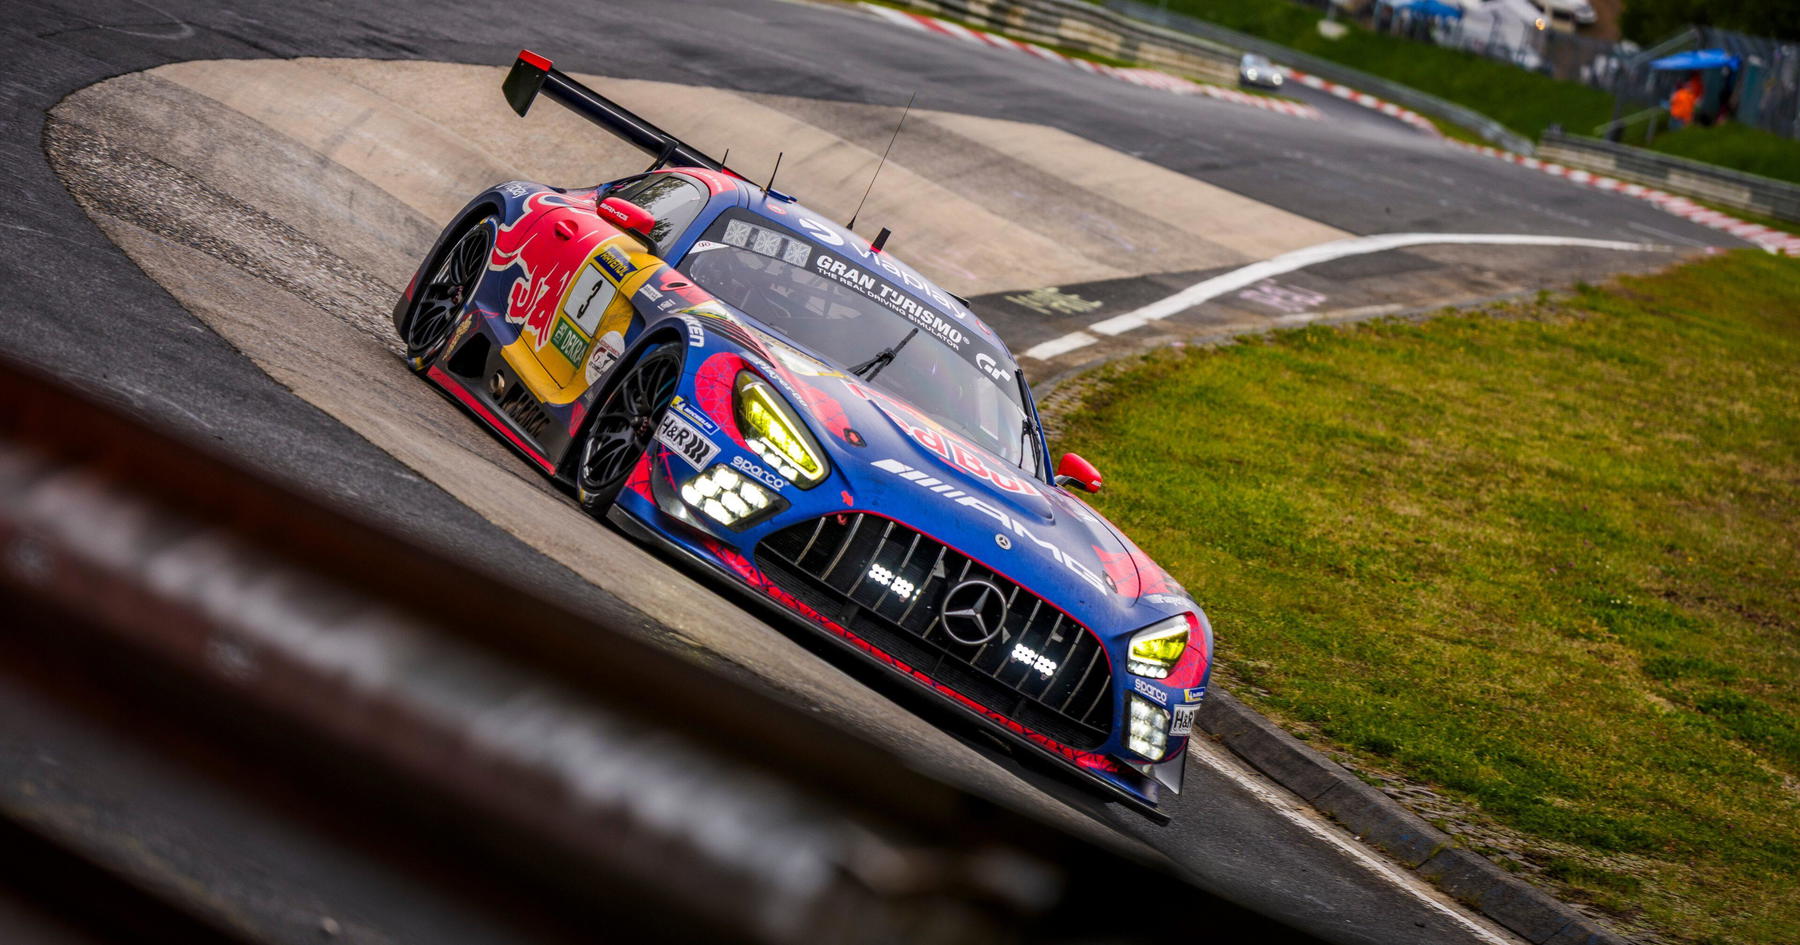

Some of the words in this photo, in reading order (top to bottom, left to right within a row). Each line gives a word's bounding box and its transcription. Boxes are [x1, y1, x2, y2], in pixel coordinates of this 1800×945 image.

[600, 251, 629, 277] RAVENOL
[817, 255, 876, 290] GRAN
[850, 242, 966, 319] viaplay
[577, 279, 603, 319] 3
[817, 267, 838, 280] THE
[840, 277, 866, 294] REAL
[867, 292, 906, 317] DRIVING
[908, 314, 959, 351] SIMULATOR
[561, 330, 588, 368] DEKRA
[1134, 679, 1168, 706] sparco
